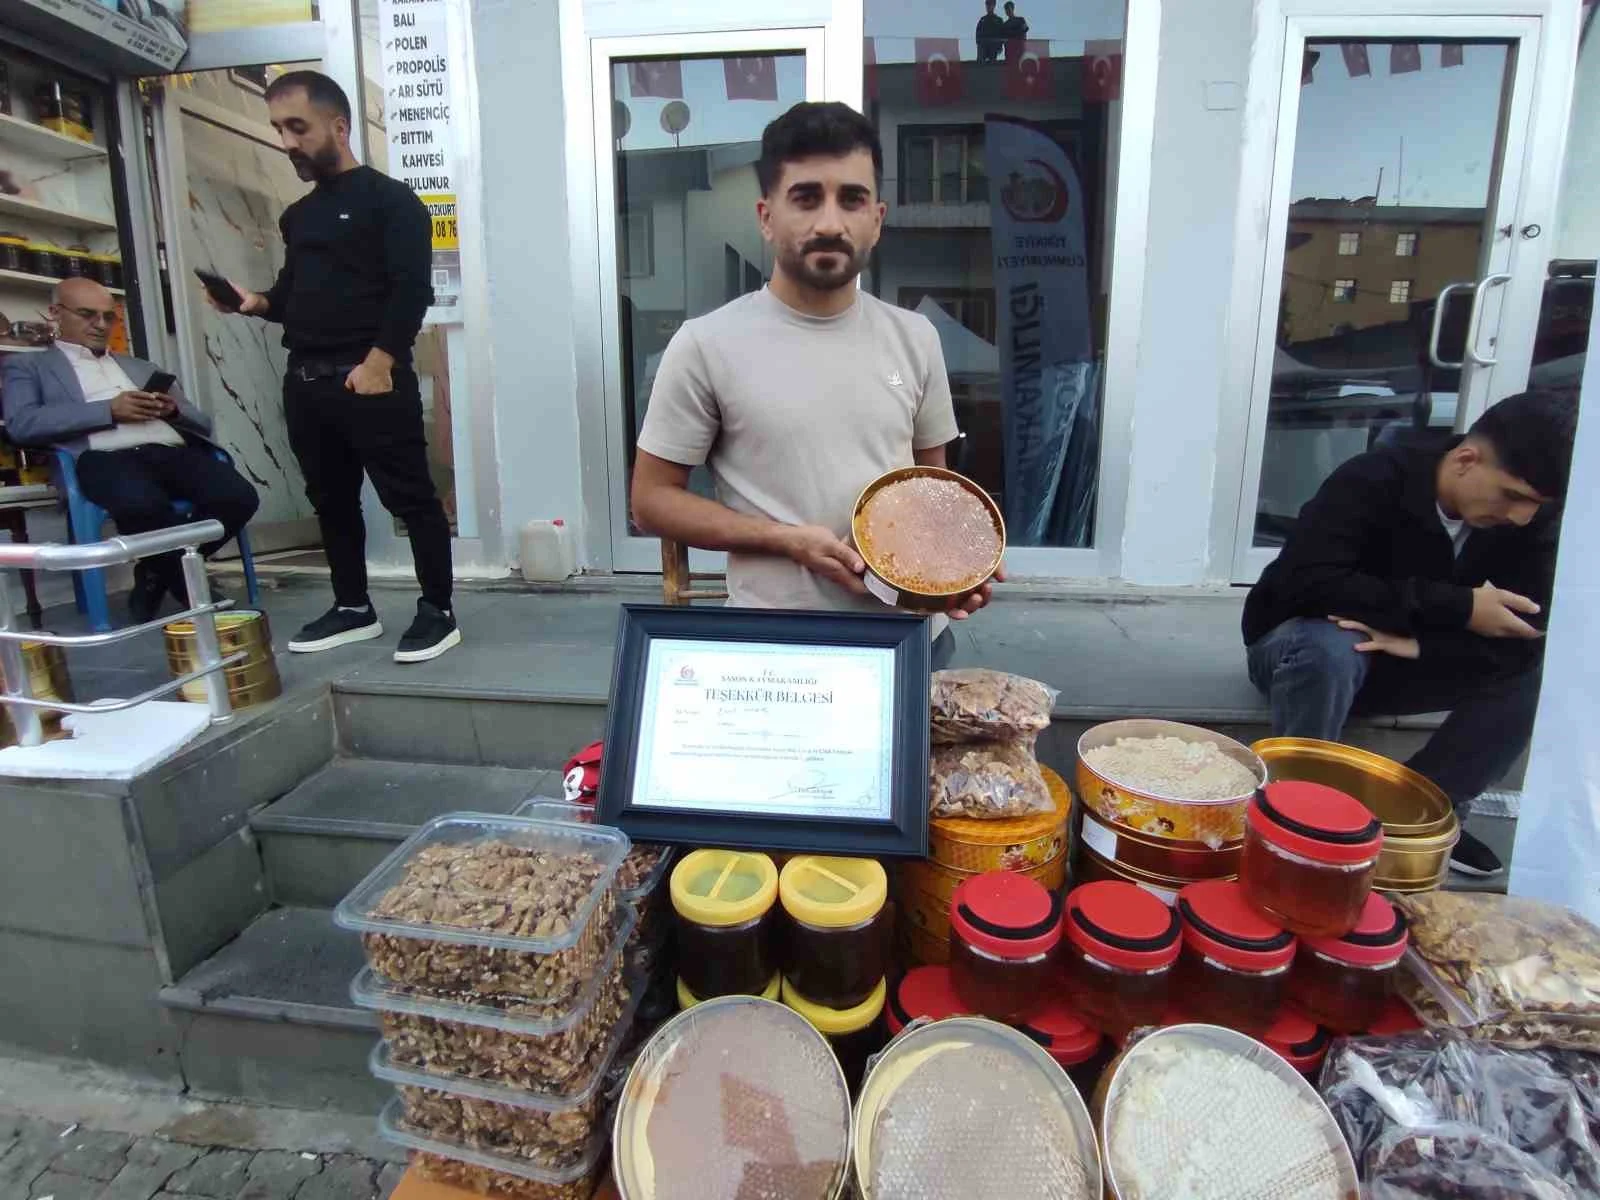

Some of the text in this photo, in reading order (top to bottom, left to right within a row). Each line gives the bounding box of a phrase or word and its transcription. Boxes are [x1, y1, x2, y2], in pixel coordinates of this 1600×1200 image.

[393, 12, 415, 27] BALI
[395, 34, 428, 51] POLEN
[396, 54, 446, 74] PROPOLİS
[399, 78, 443, 97] ARI SÜTÜ
[402, 147, 444, 168] KAHVESİ
[704, 687, 833, 704] TEŞEKKÜR BELGESİ
